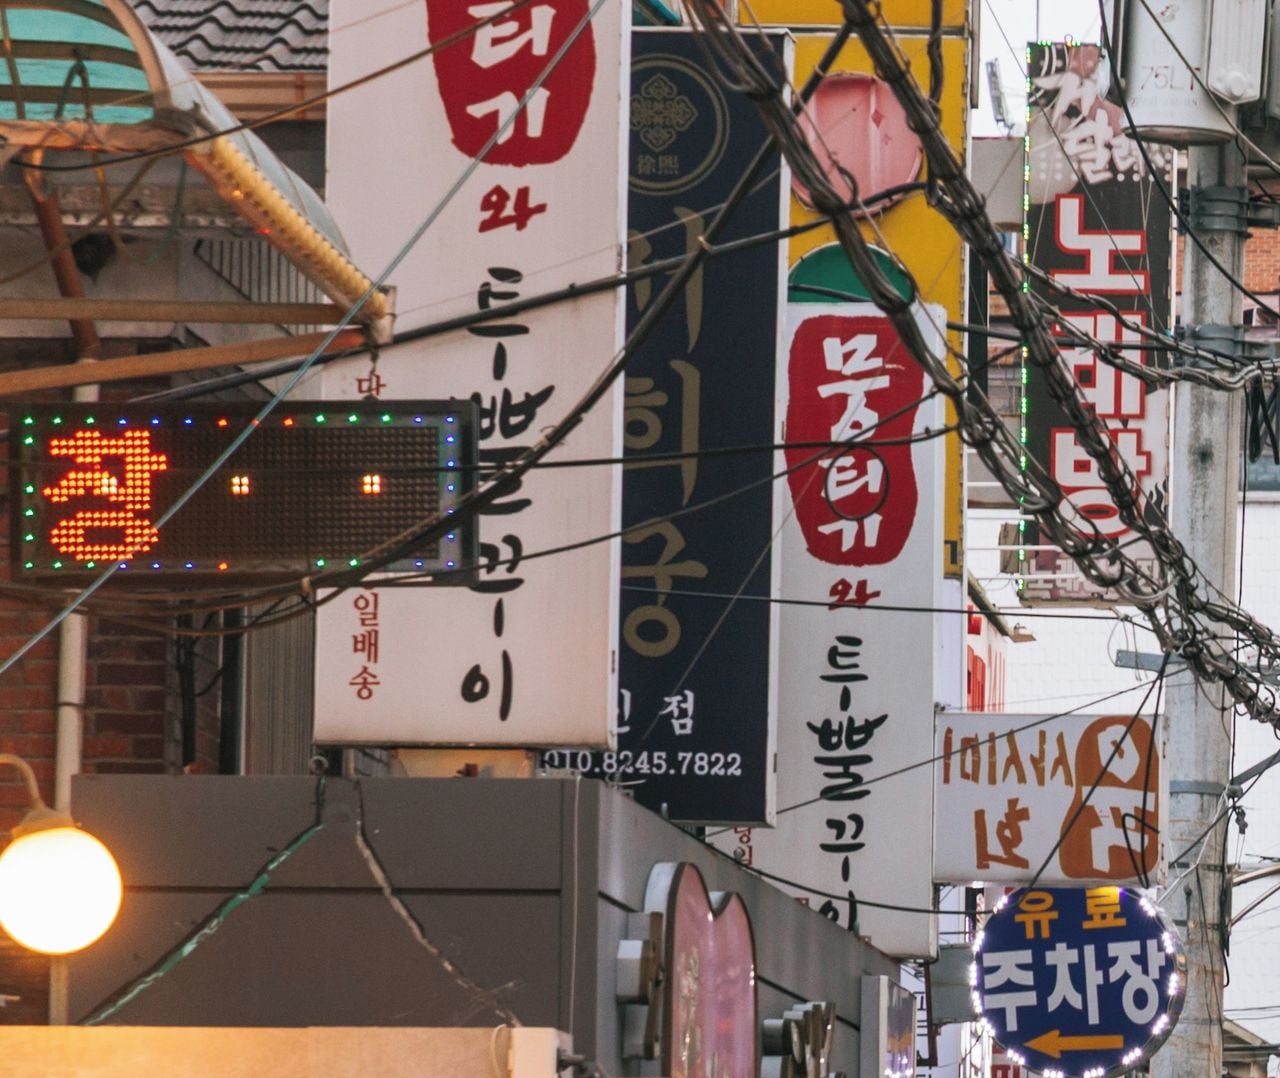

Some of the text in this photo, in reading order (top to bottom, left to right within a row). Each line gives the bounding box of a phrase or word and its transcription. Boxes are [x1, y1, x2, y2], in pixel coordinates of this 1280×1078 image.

[478, 186, 548, 233] 와
[1049, 193, 1152, 539] 노래방
[818, 334, 891, 553] 뭉티기
[828, 579, 881, 610] 와
[349, 590, 380, 700] 일배송
[545, 751, 742, 776] 010.8245.7822
[1014, 888, 1126, 939] 유료
[982, 939, 1165, 1031] 주차장
